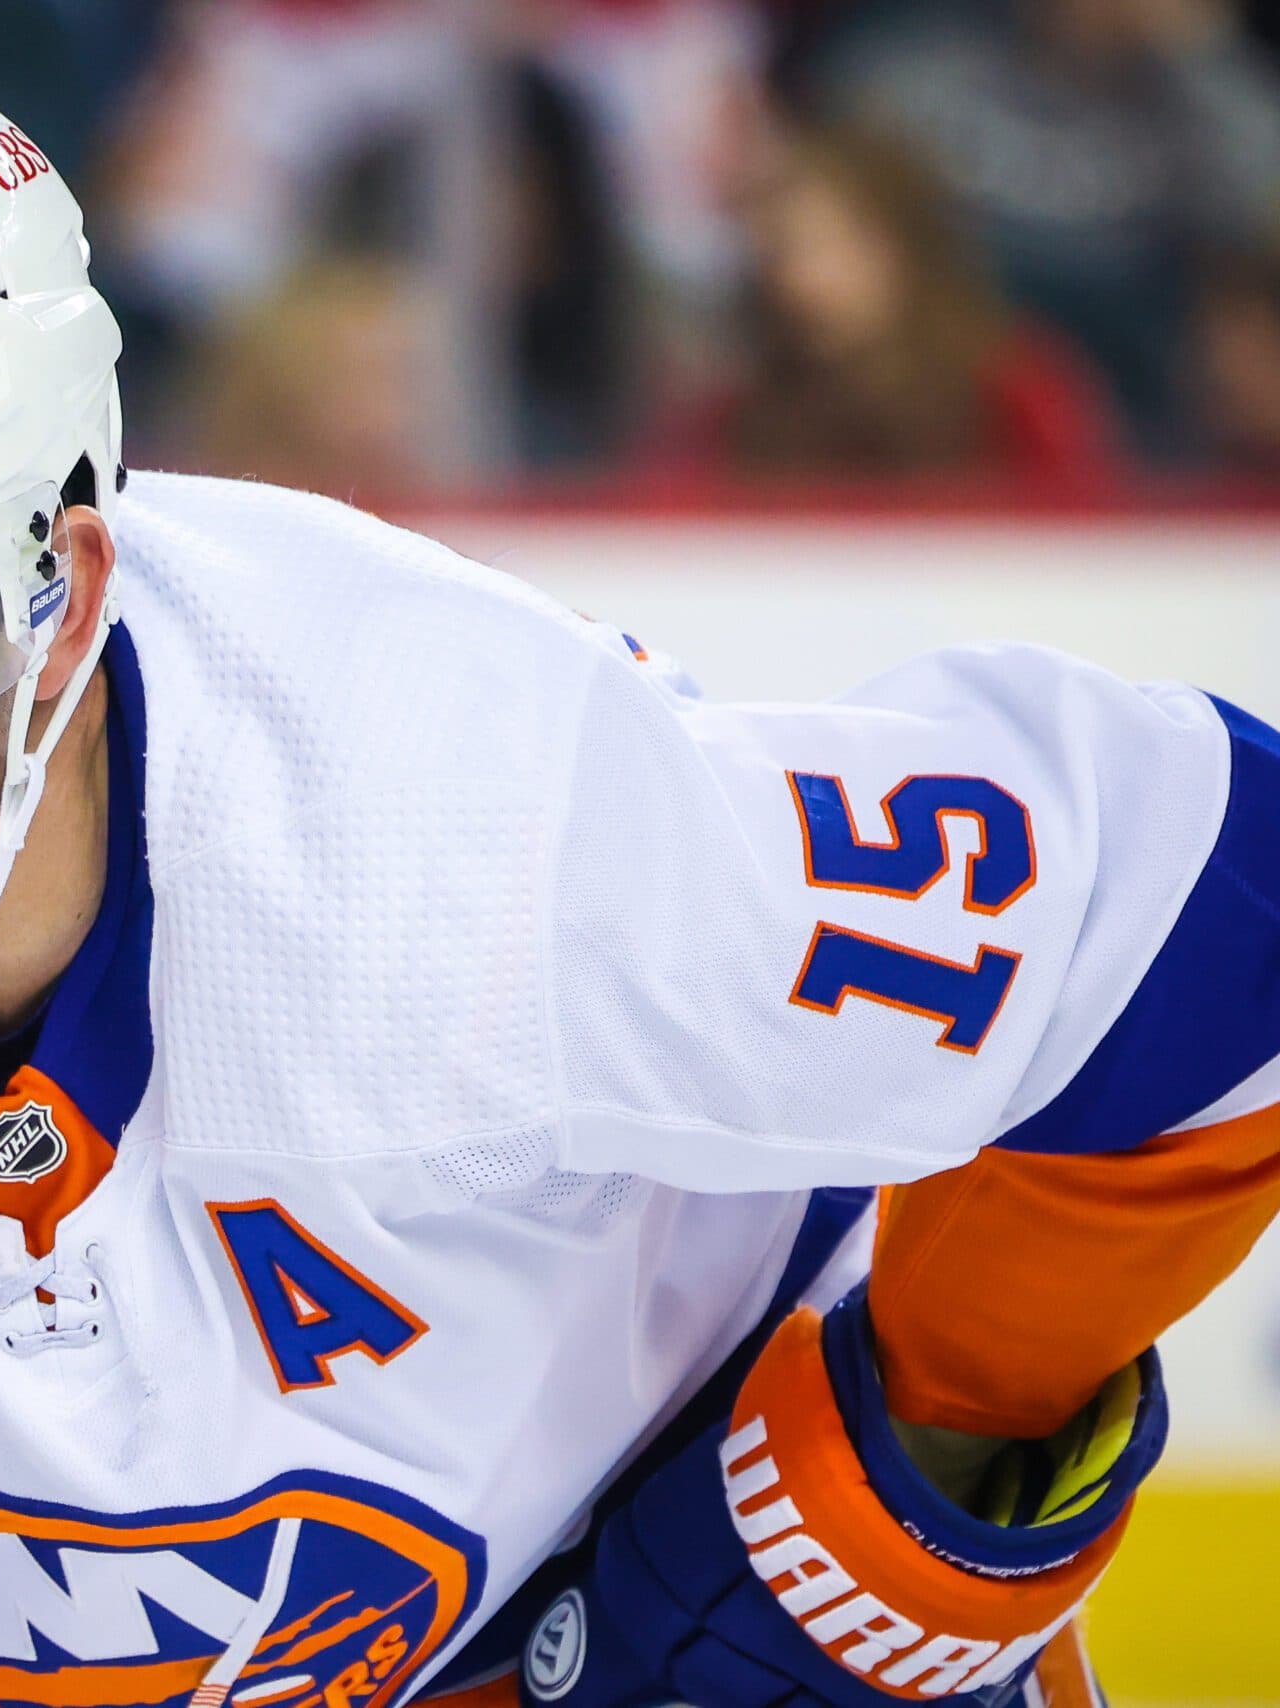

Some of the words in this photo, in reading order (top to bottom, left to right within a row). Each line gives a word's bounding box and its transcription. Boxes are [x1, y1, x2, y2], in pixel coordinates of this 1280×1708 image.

[31, 582, 65, 614] BAUER
[785, 769, 1038, 1057] 15
[204, 1197, 431, 1394] A
